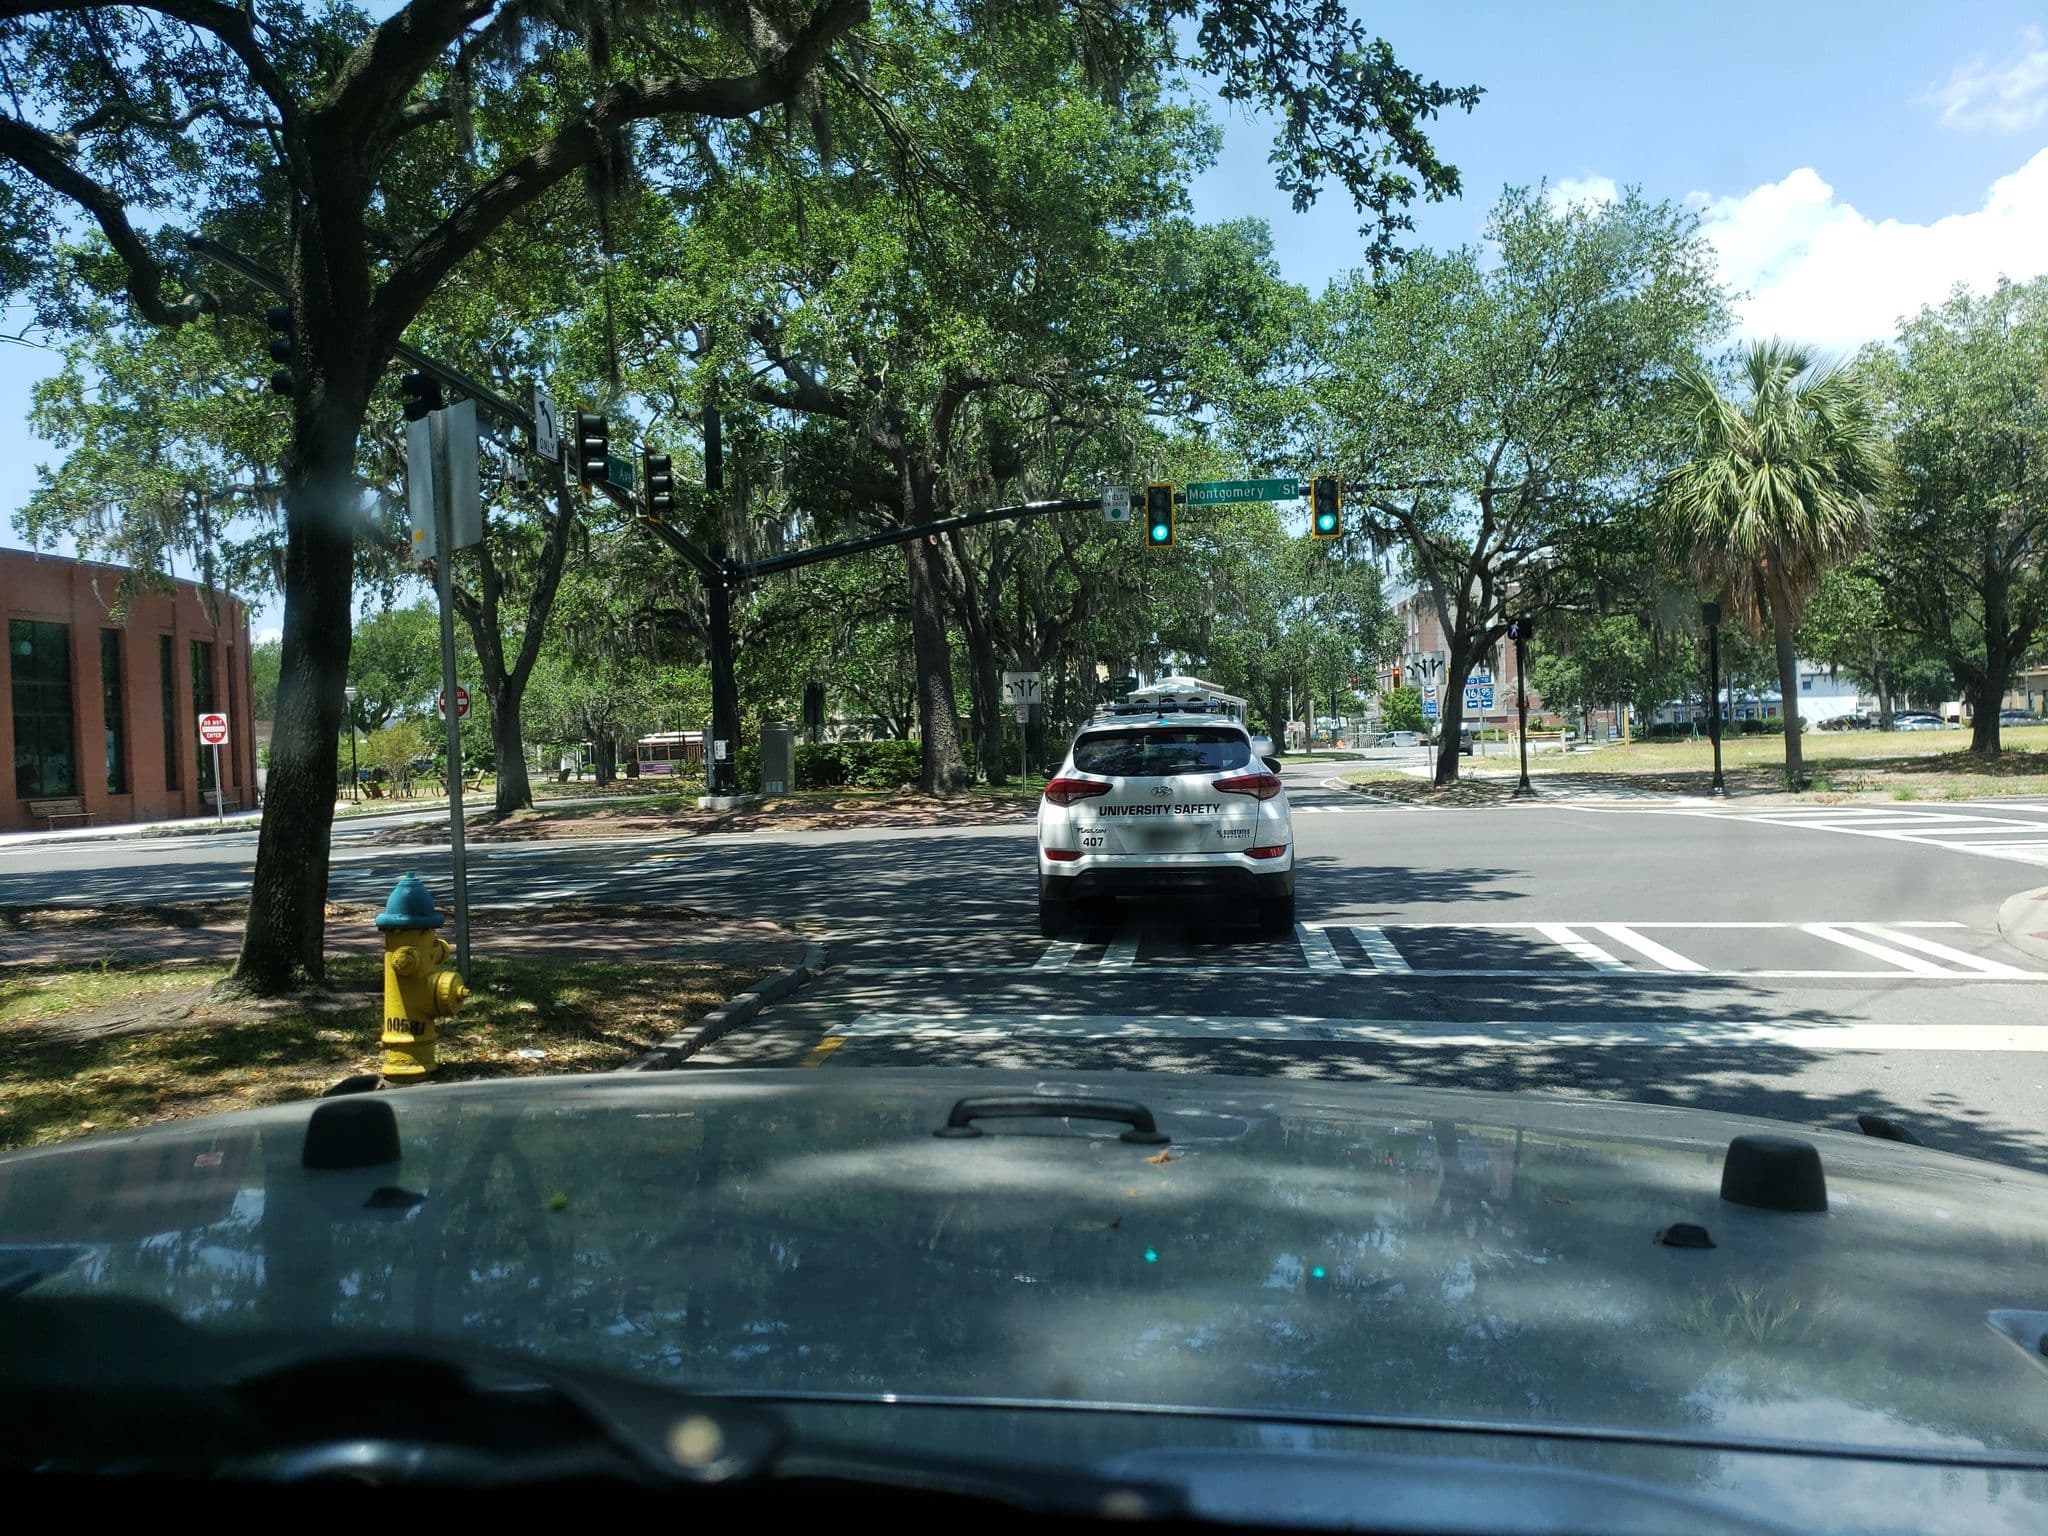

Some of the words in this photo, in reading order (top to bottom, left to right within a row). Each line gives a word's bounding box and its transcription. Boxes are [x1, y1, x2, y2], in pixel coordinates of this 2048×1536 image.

[539, 437, 555, 453] ONLY
[1189, 487, 1264, 501] Montgomery
[1283, 484, 1296, 495] St
[1467, 690, 1477, 698] 16
[1481, 688, 1491, 696] 95
[1100, 804, 1171, 816] UNIVERSITY
[1174, 804, 1221, 815] SAFETY
[1083, 837, 1103, 846] 407
